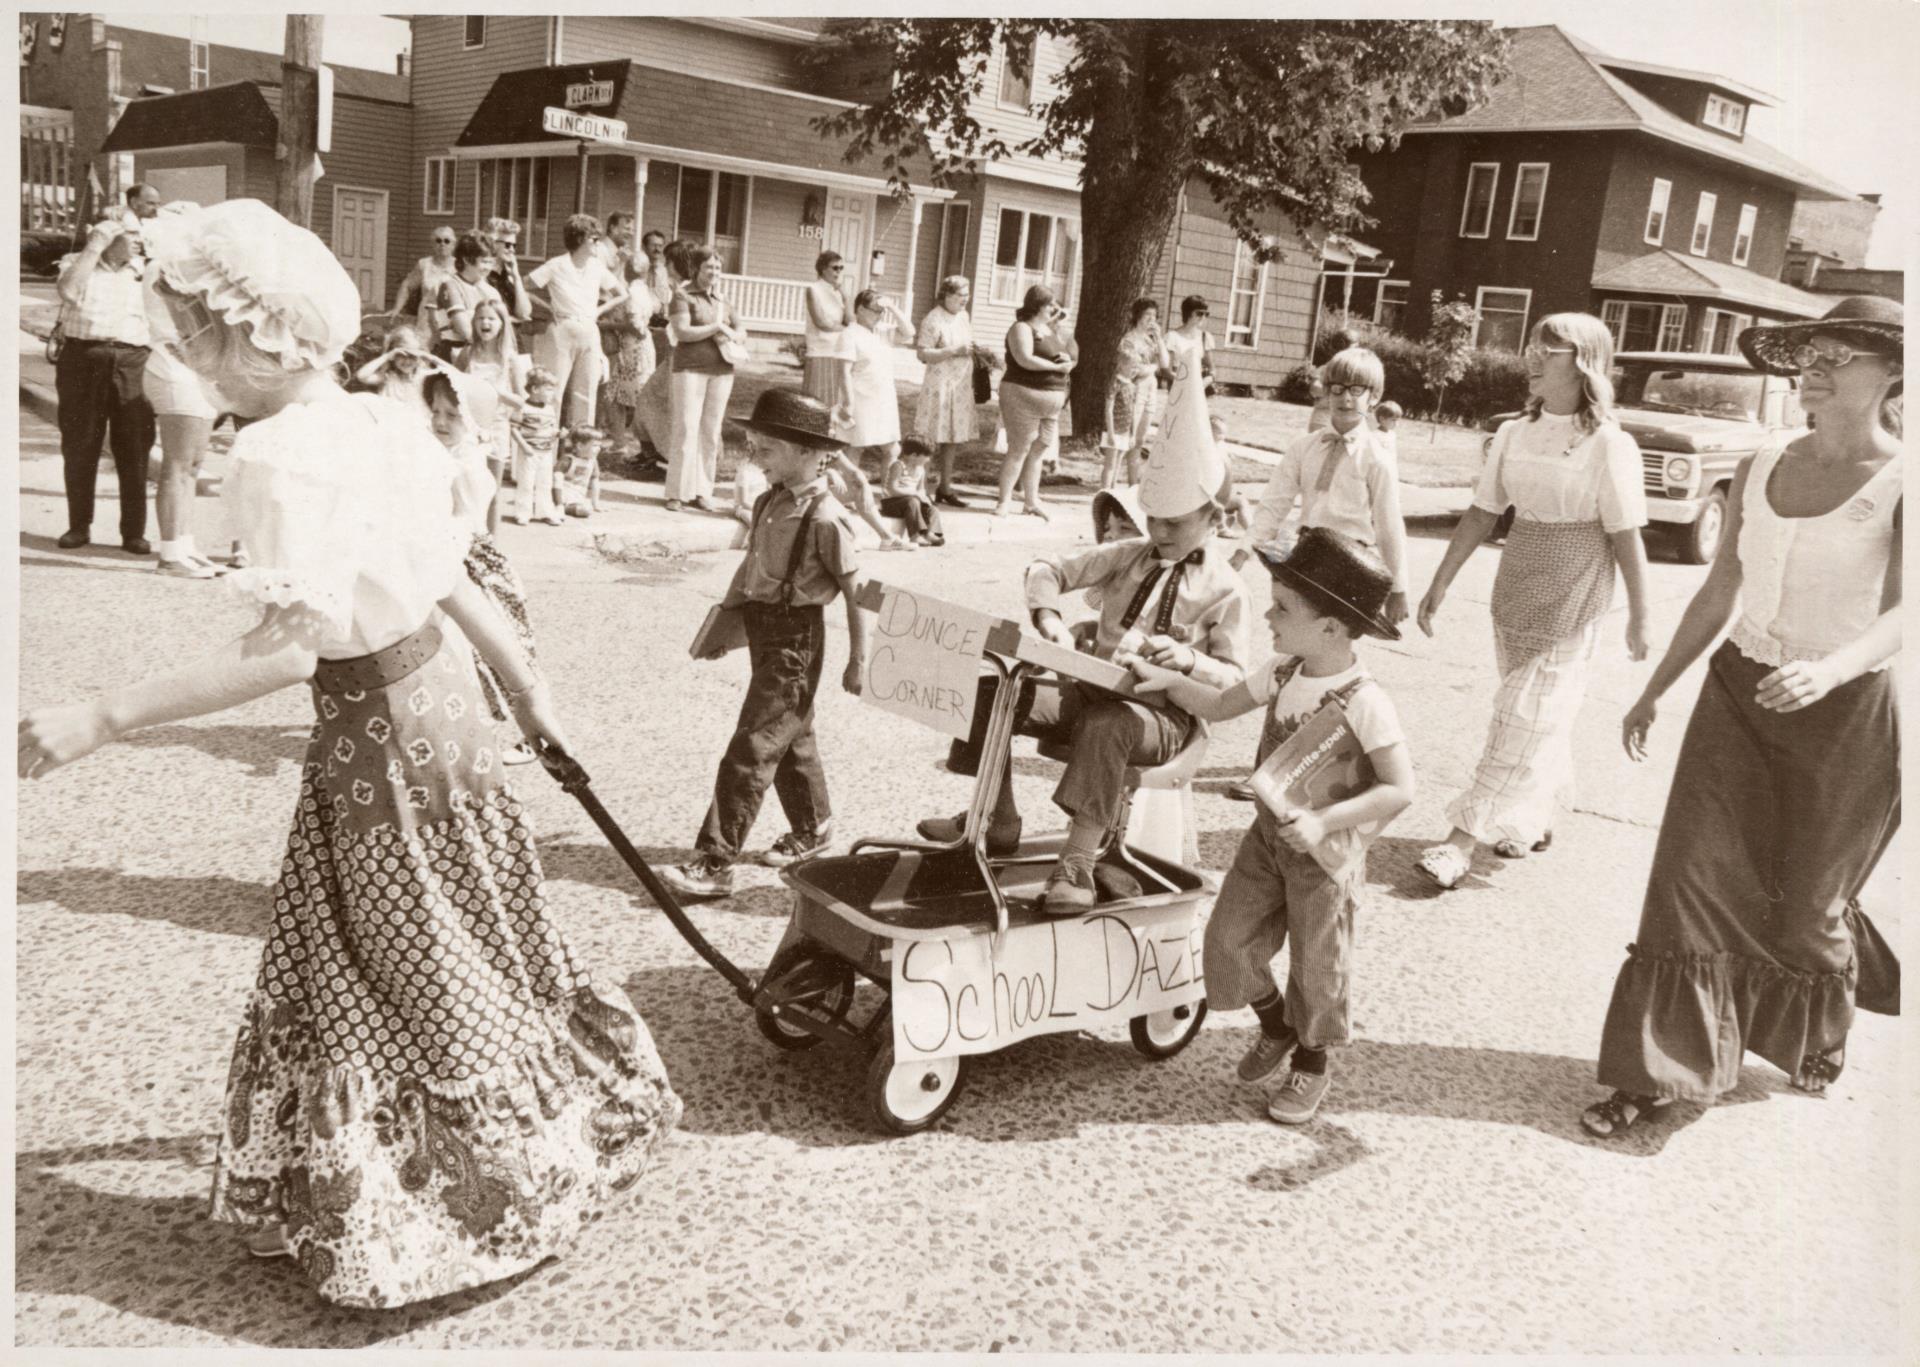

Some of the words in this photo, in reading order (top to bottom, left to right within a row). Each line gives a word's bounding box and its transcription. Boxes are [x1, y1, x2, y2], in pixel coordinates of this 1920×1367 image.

[571, 86, 600, 104] CLARK
[551, 112, 610, 138] LINCOLN
[799, 225, 824, 240] 158
[878, 590, 978, 657] DUNCE
[869, 645, 967, 722] CORNER
